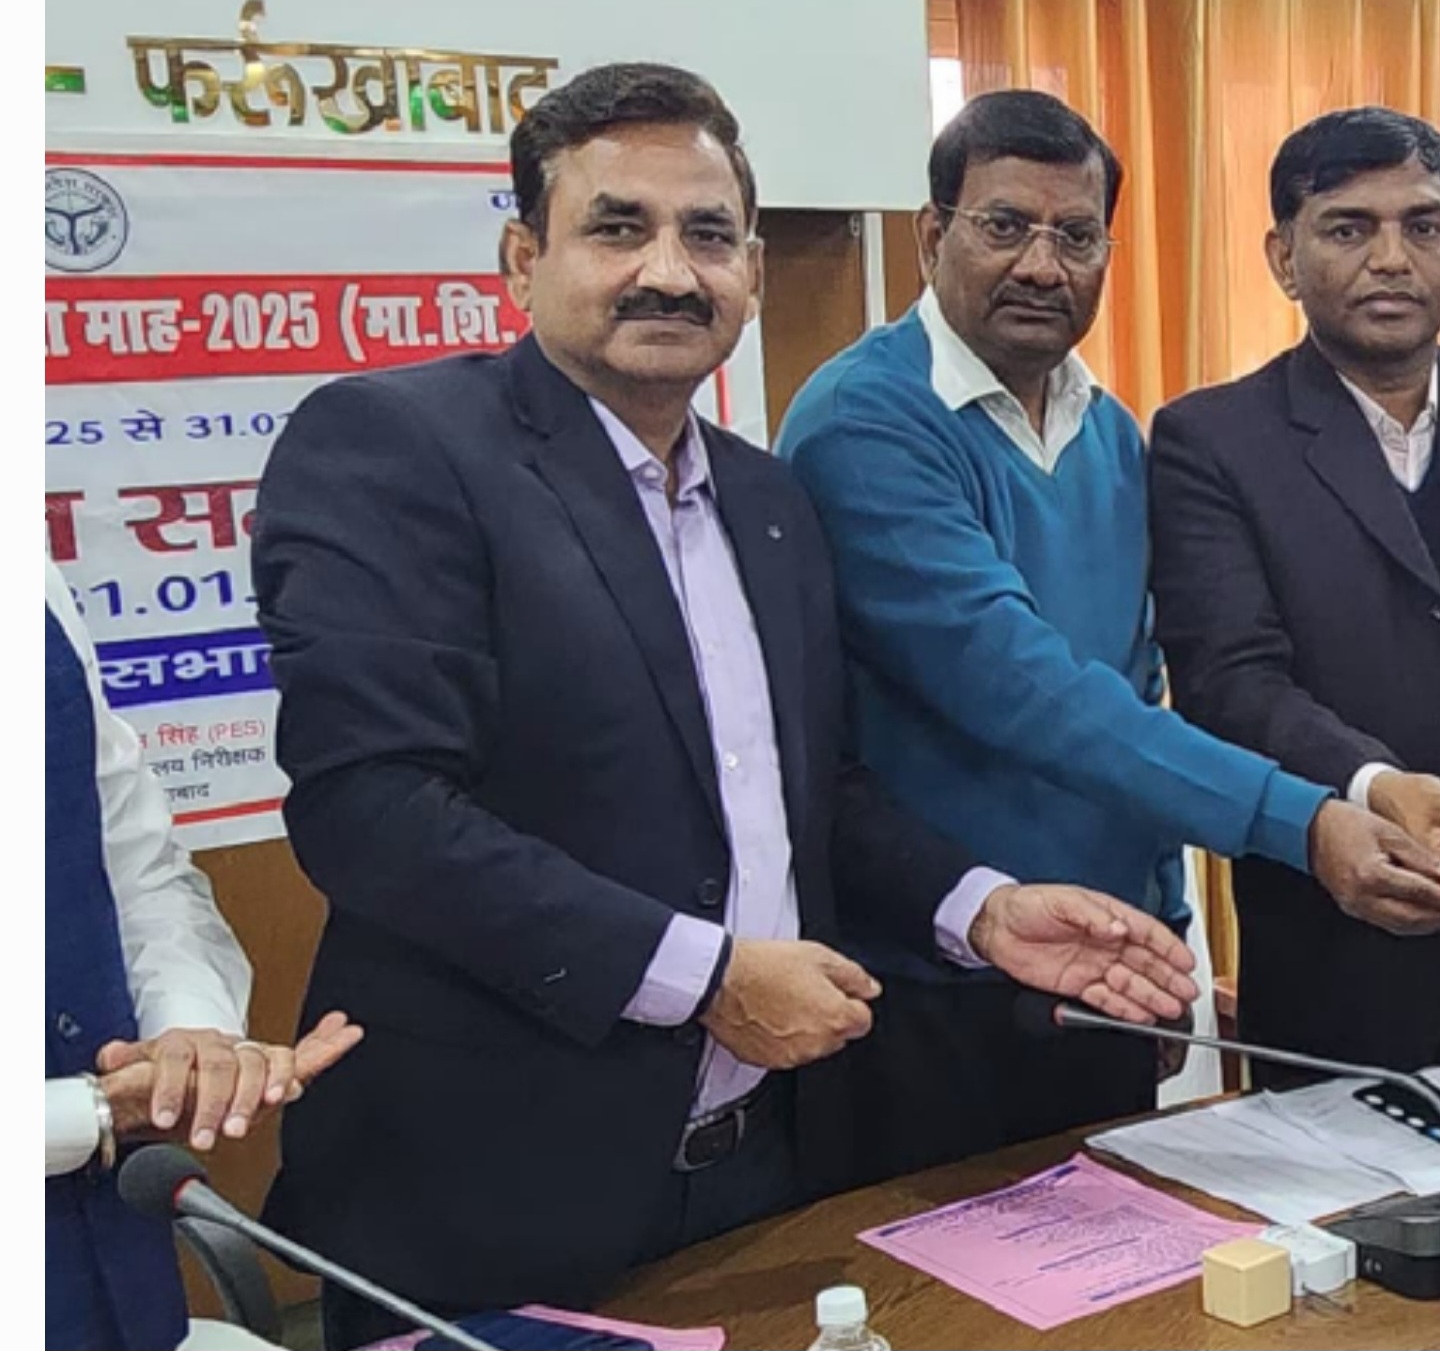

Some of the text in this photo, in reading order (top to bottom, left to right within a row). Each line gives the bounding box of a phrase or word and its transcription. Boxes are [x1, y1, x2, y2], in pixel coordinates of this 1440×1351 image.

[76, 291, 320, 356] माह-2025
[340, 282, 517, 362] (मा.शि.
[45, 409, 294, 445] 25 से 31.0
[100, 643, 273, 689] सभा
[157, 723, 199, 748] सिंह
[208, 719, 265, 744] (PES)
[149, 758, 184, 777] लय
